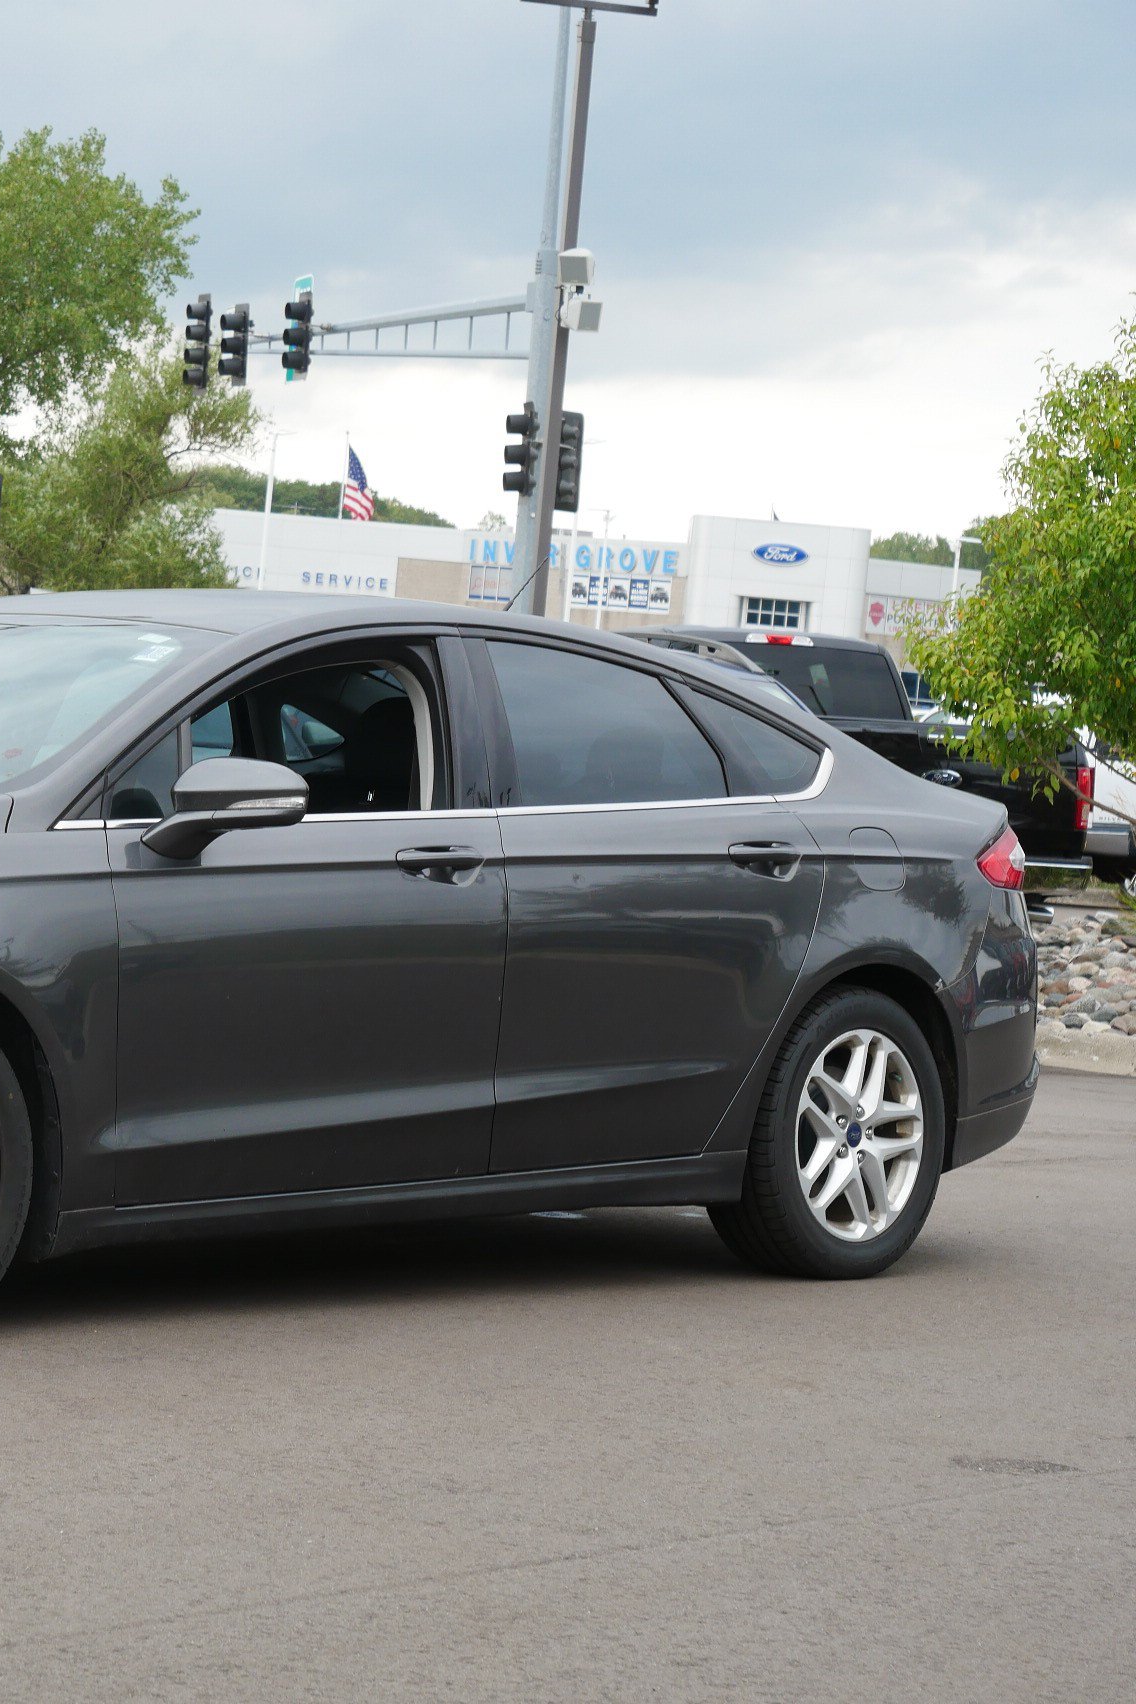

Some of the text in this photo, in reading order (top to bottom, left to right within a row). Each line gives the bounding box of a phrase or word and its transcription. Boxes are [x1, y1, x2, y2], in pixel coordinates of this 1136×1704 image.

[468, 538, 679, 574] INVR GROVE
[764, 547, 797, 562] Ford
[302, 571, 389, 590] SERVICE
